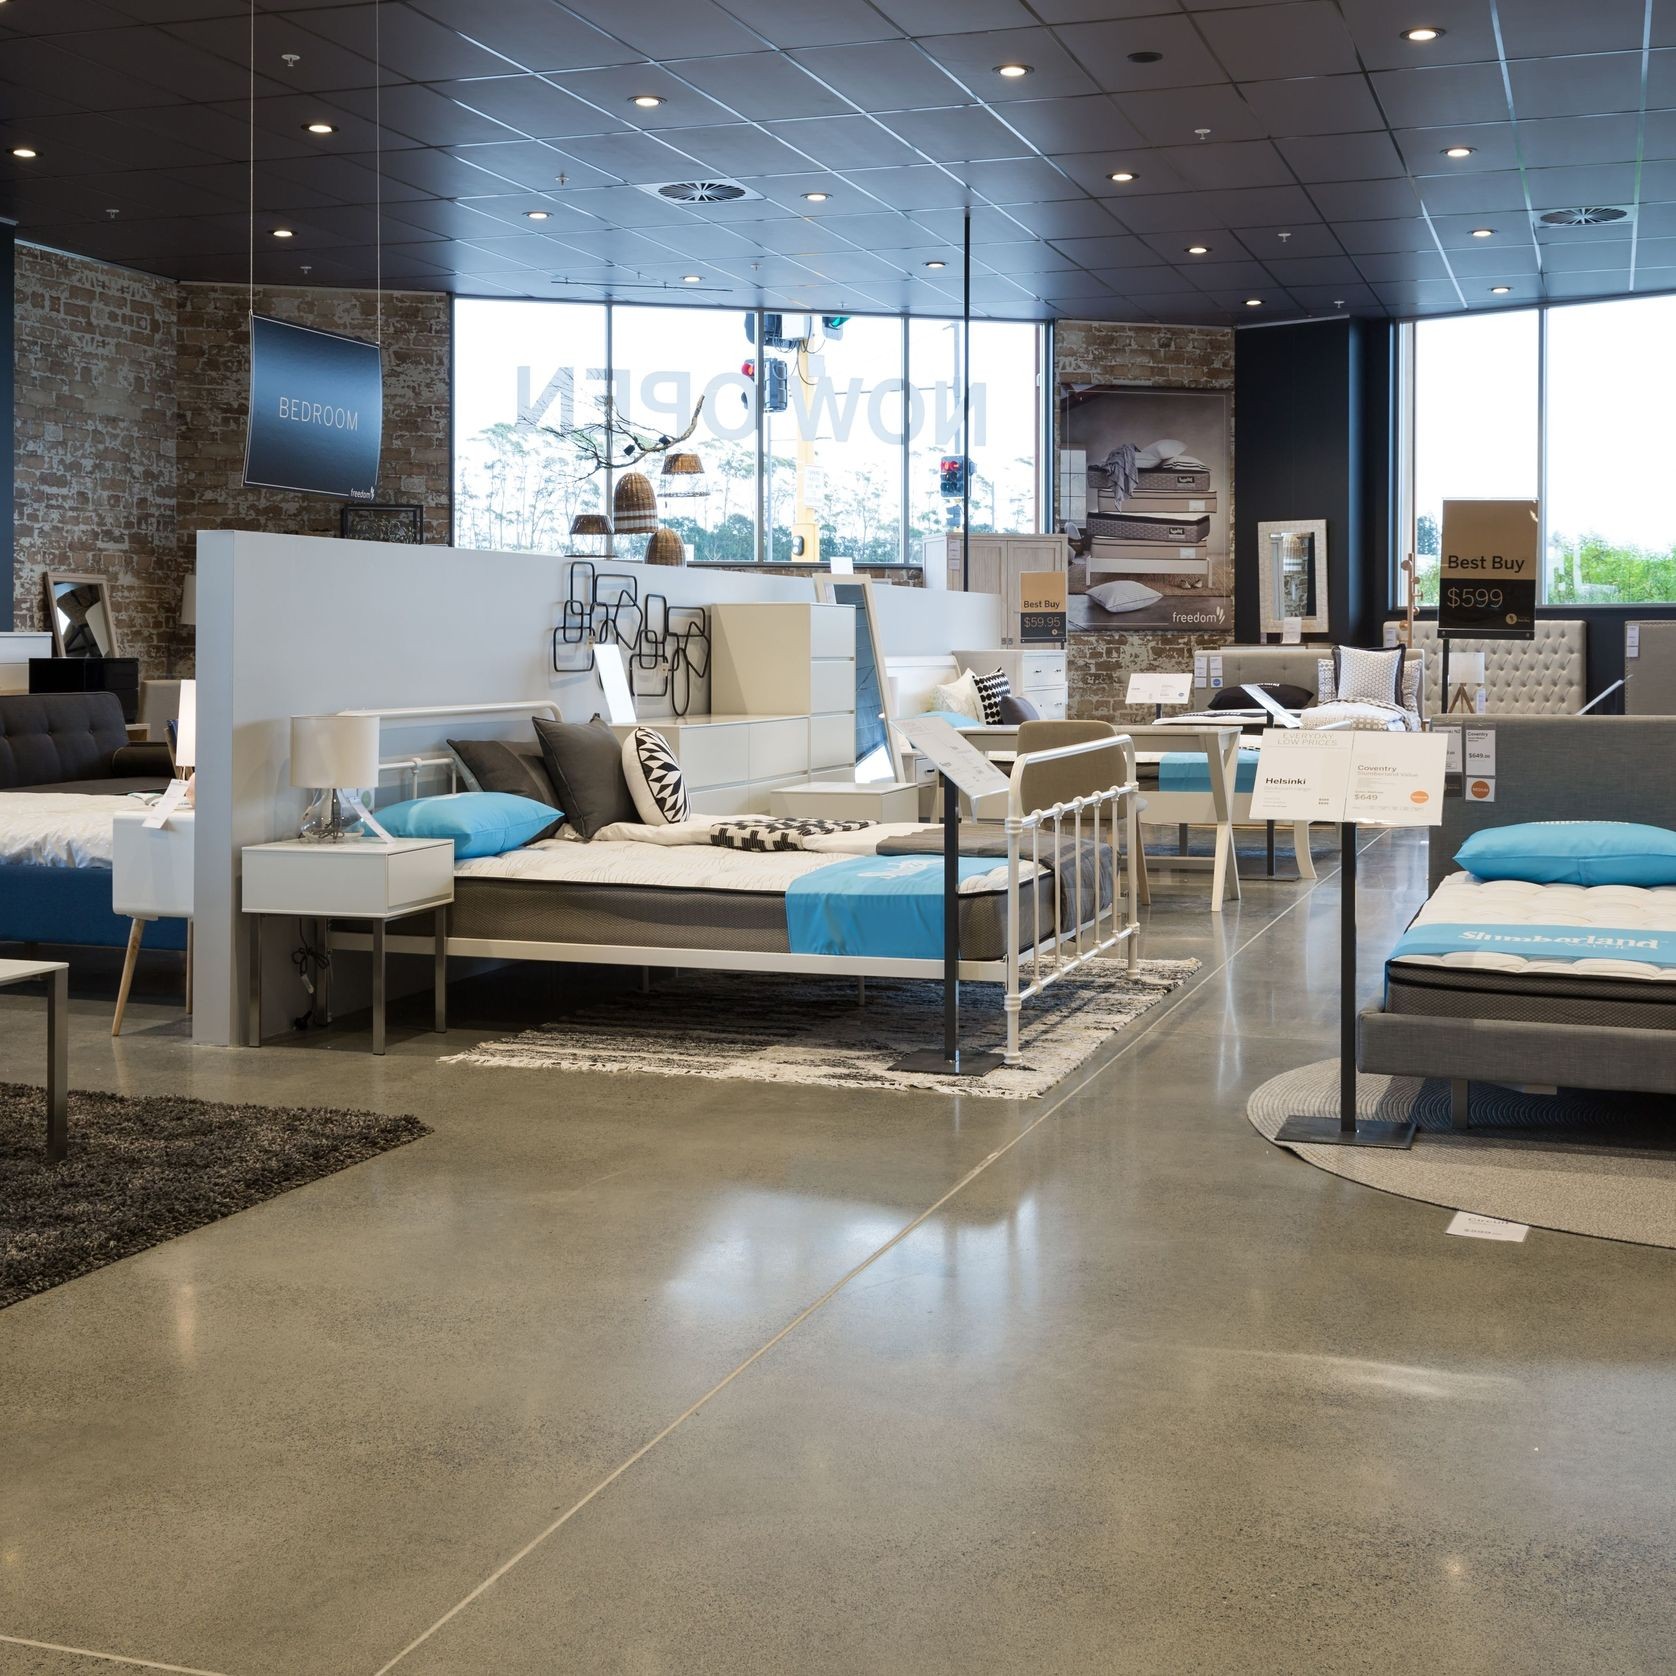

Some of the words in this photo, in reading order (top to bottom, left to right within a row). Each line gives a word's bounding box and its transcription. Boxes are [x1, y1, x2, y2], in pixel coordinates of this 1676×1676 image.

[279, 396, 358, 431] BEDROOM
[350, 488, 371, 499] freedom
[1448, 555, 1486, 570] Best
[1492, 555, 1525, 573] Buy
[1447, 586, 1503, 608] $599
[1023, 600, 1042, 608] Best
[1044, 600, 1060, 609] Buy
[1023, 616, 1061, 628] $59.95
[1172, 611, 1217, 623] freedom
[1357, 764, 1397, 772] Coventry
[1265, 777, 1306, 785] Helsinki
[1458, 931, 1658, 949] Slumberland
